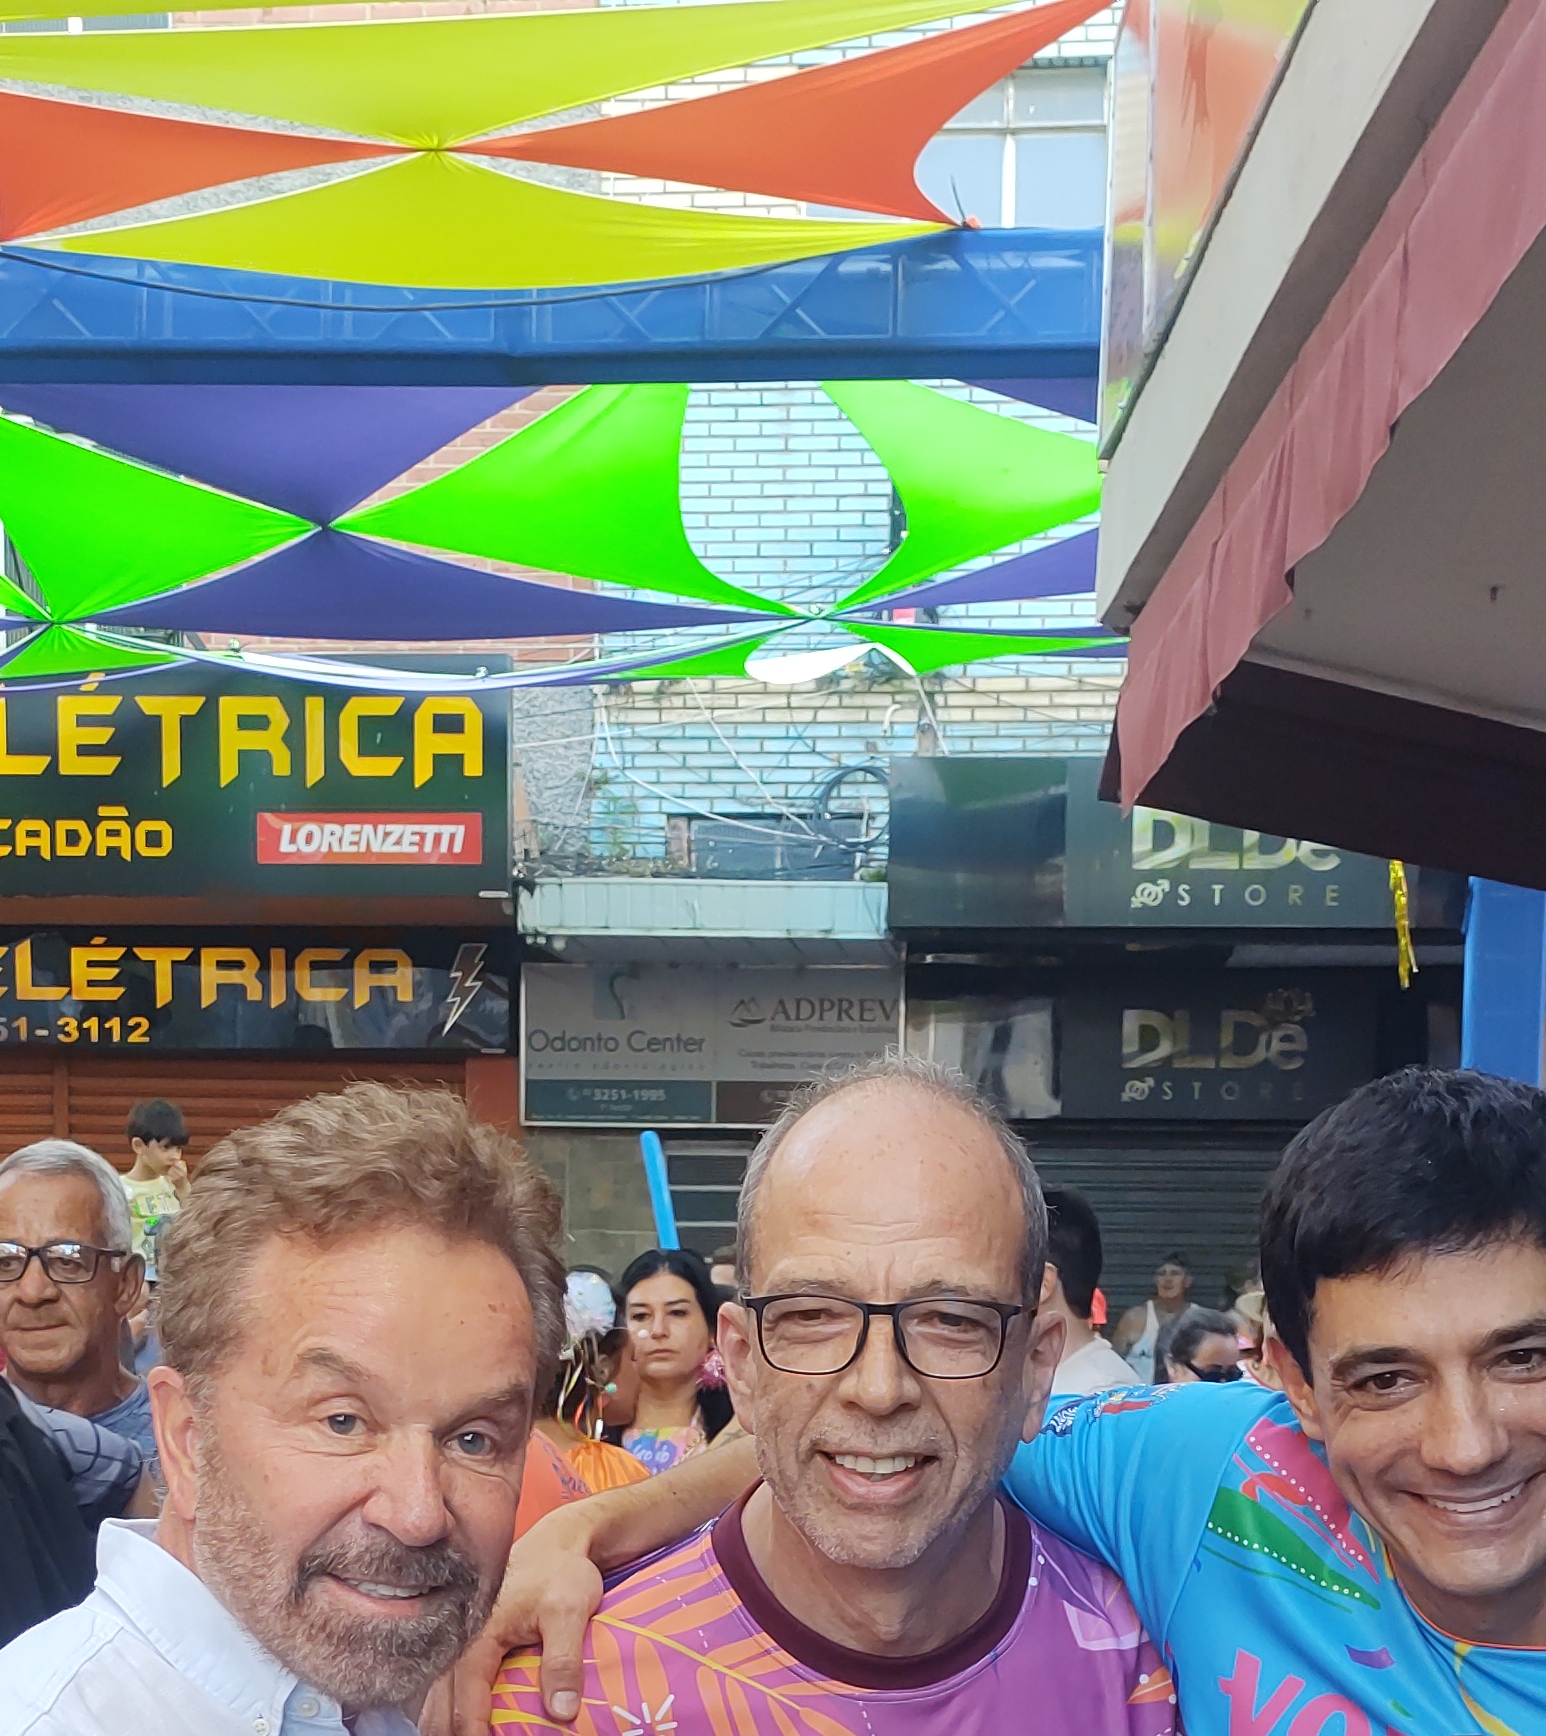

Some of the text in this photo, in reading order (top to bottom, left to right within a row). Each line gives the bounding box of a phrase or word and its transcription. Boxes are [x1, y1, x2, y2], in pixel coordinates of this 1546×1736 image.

[279, 823, 466, 855] LORENZETTI
[770, 997, 898, 1023] ADPREV
[528, 1029, 704, 1053] Odonto Center
